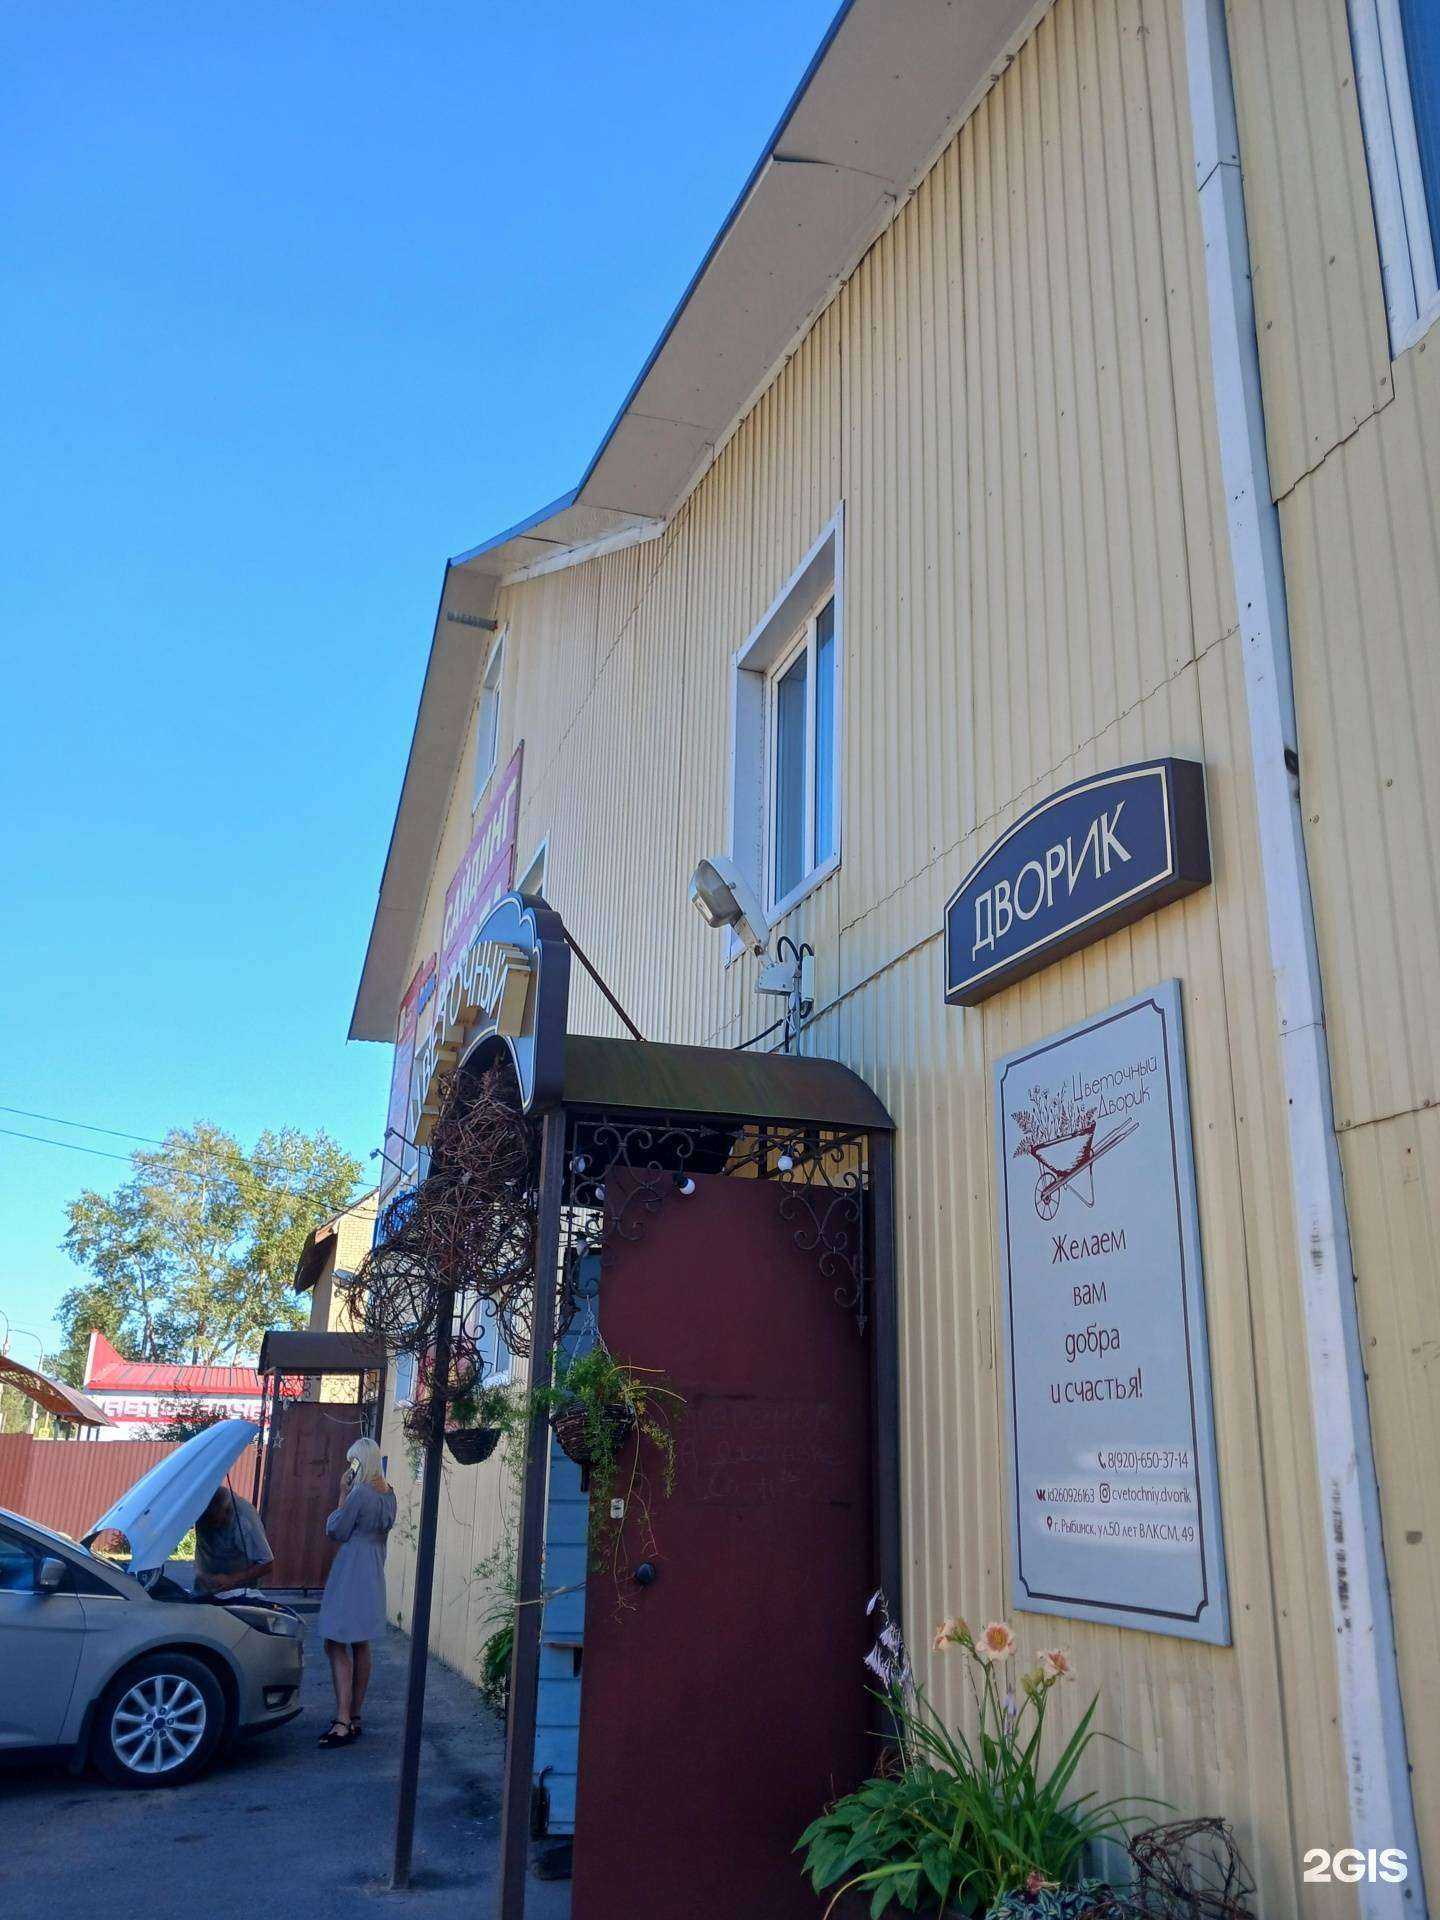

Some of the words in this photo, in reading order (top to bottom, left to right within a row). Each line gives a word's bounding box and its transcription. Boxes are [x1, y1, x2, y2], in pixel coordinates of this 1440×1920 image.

[972, 800, 1132, 962] ДВОРИК
[1072, 1055, 1158, 1102] Цветочный
[1097, 1079, 1152, 1119] Дворик
[1052, 1229, 1128, 1265] Желаем
[1073, 1281, 1107, 1307] вам
[1065, 1322, 1120, 1363] добра
[1112, 1485, 1192, 1506] cvetochniy.dvorik
